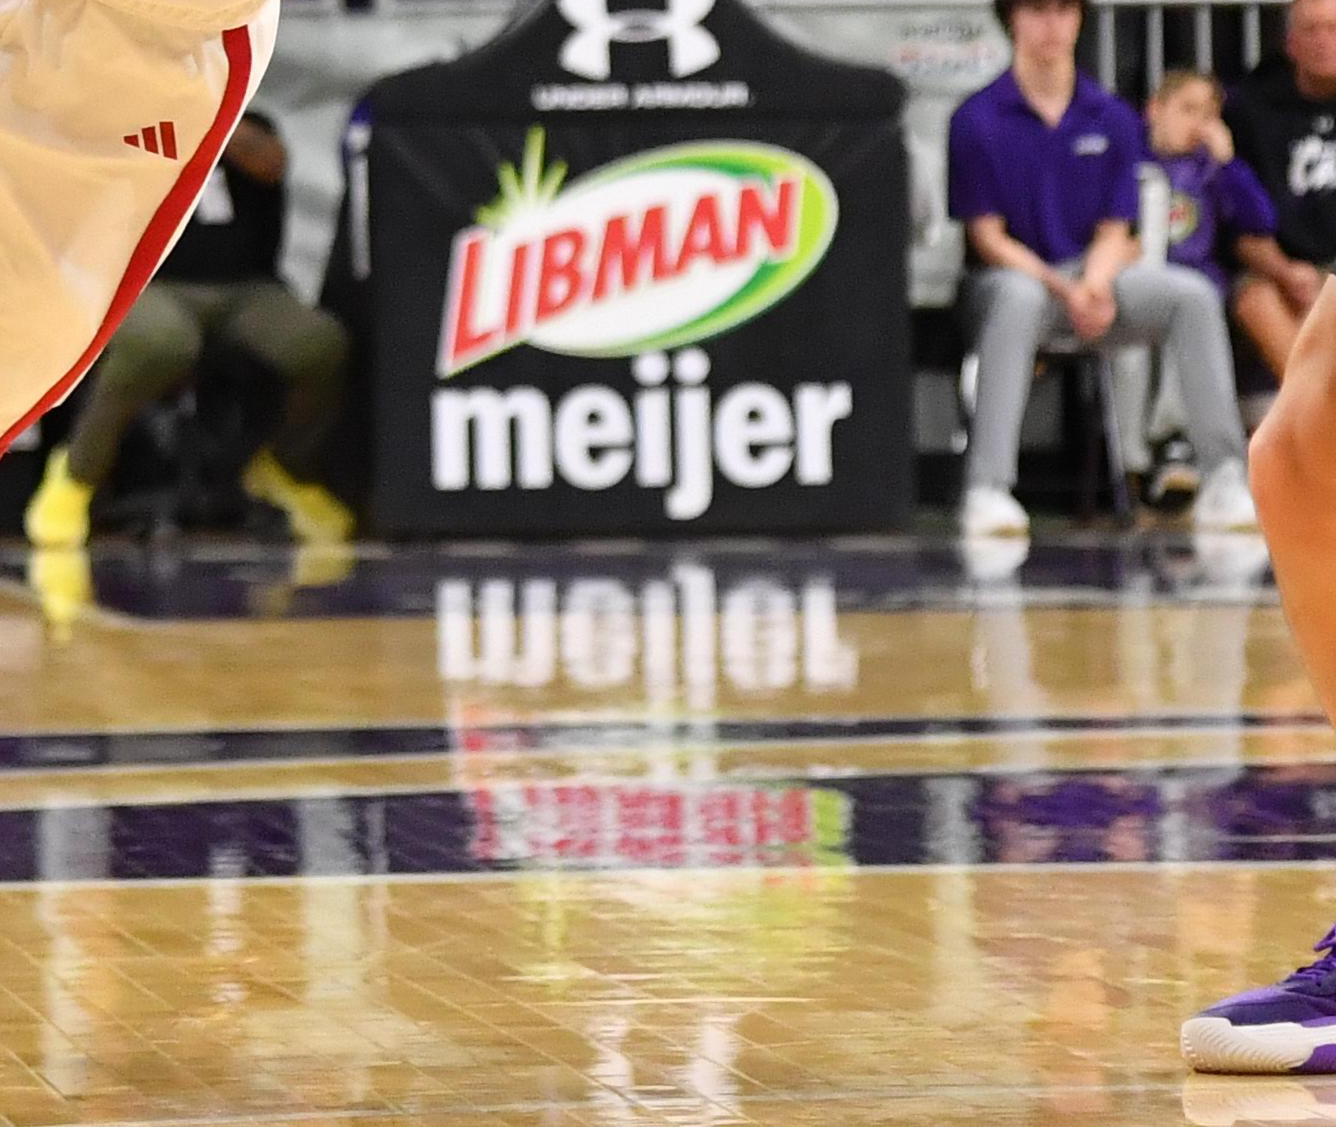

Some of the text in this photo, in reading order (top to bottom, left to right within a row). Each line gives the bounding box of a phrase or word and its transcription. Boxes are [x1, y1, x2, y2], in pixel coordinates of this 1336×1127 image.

[531, 81, 629, 111] UNDER
[450, 174, 798, 364] LIBMAN
[431, 348, 852, 521] meijer
